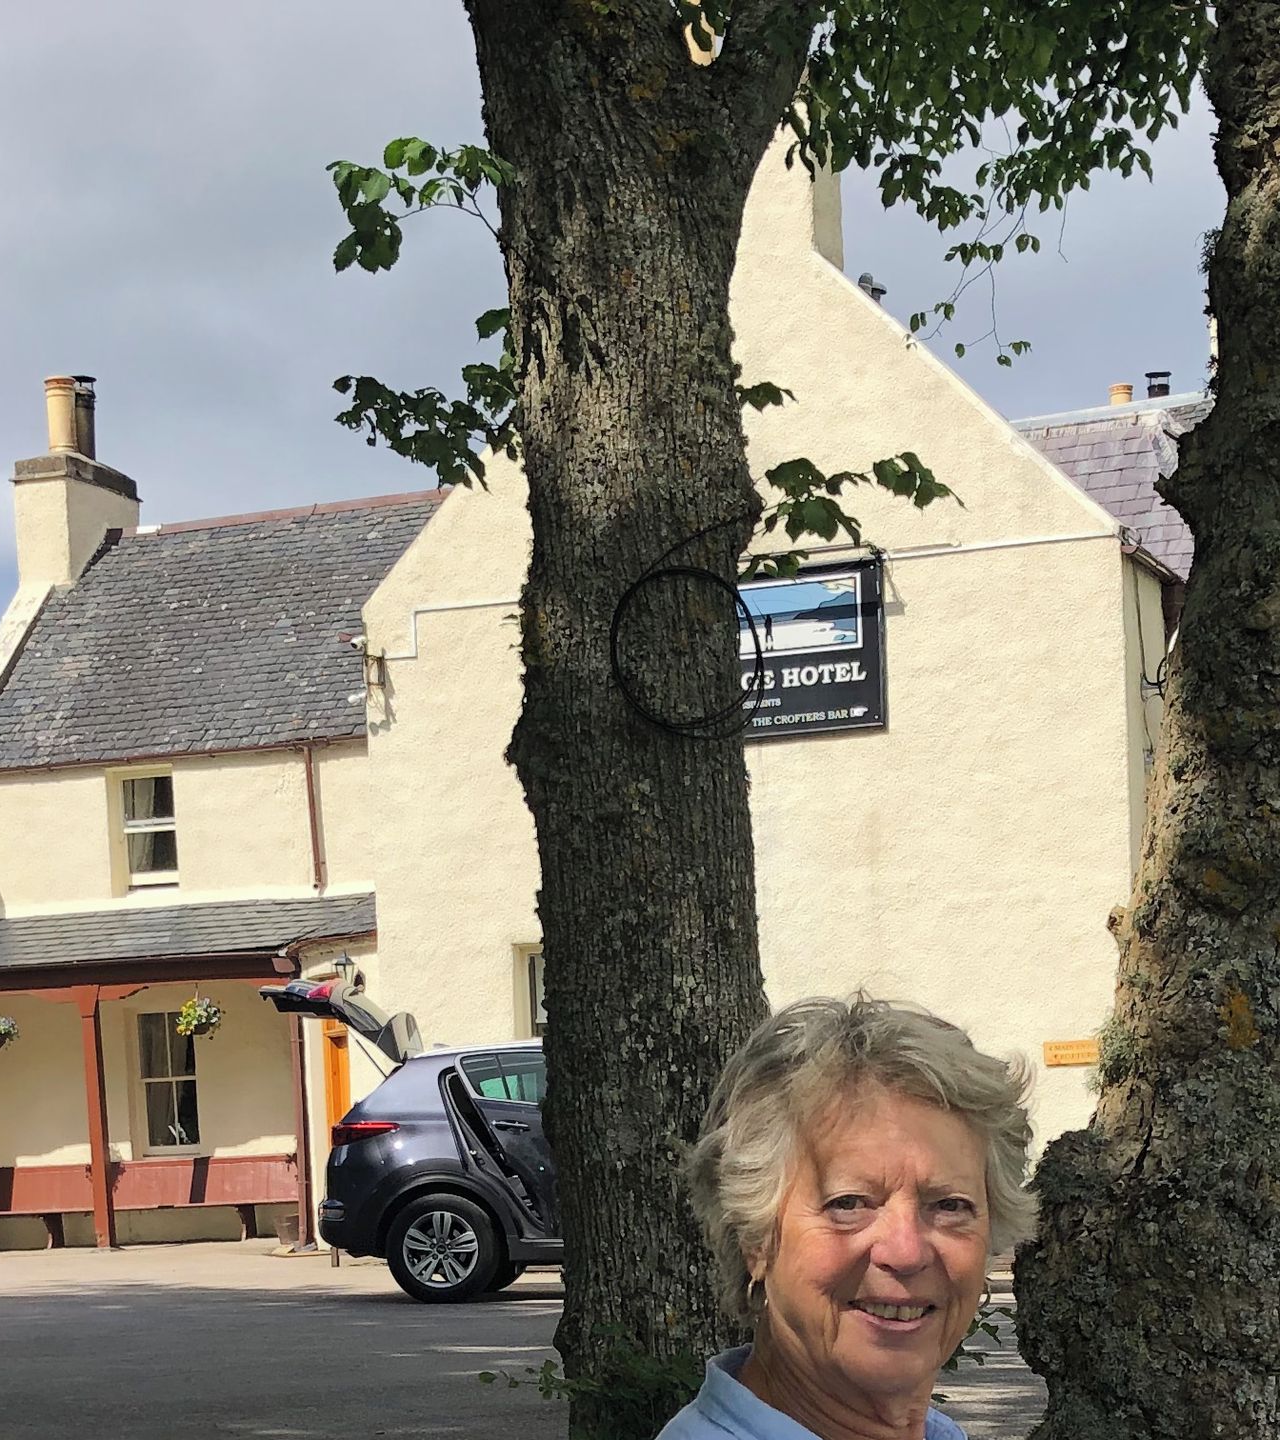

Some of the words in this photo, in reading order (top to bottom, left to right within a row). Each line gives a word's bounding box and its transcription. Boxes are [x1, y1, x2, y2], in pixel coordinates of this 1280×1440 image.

[781, 661, 867, 688] HOTEL
[752, 716, 772, 727] THE
[774, 711, 826, 725] CROFTERS
[827, 709, 849, 720] BAR
